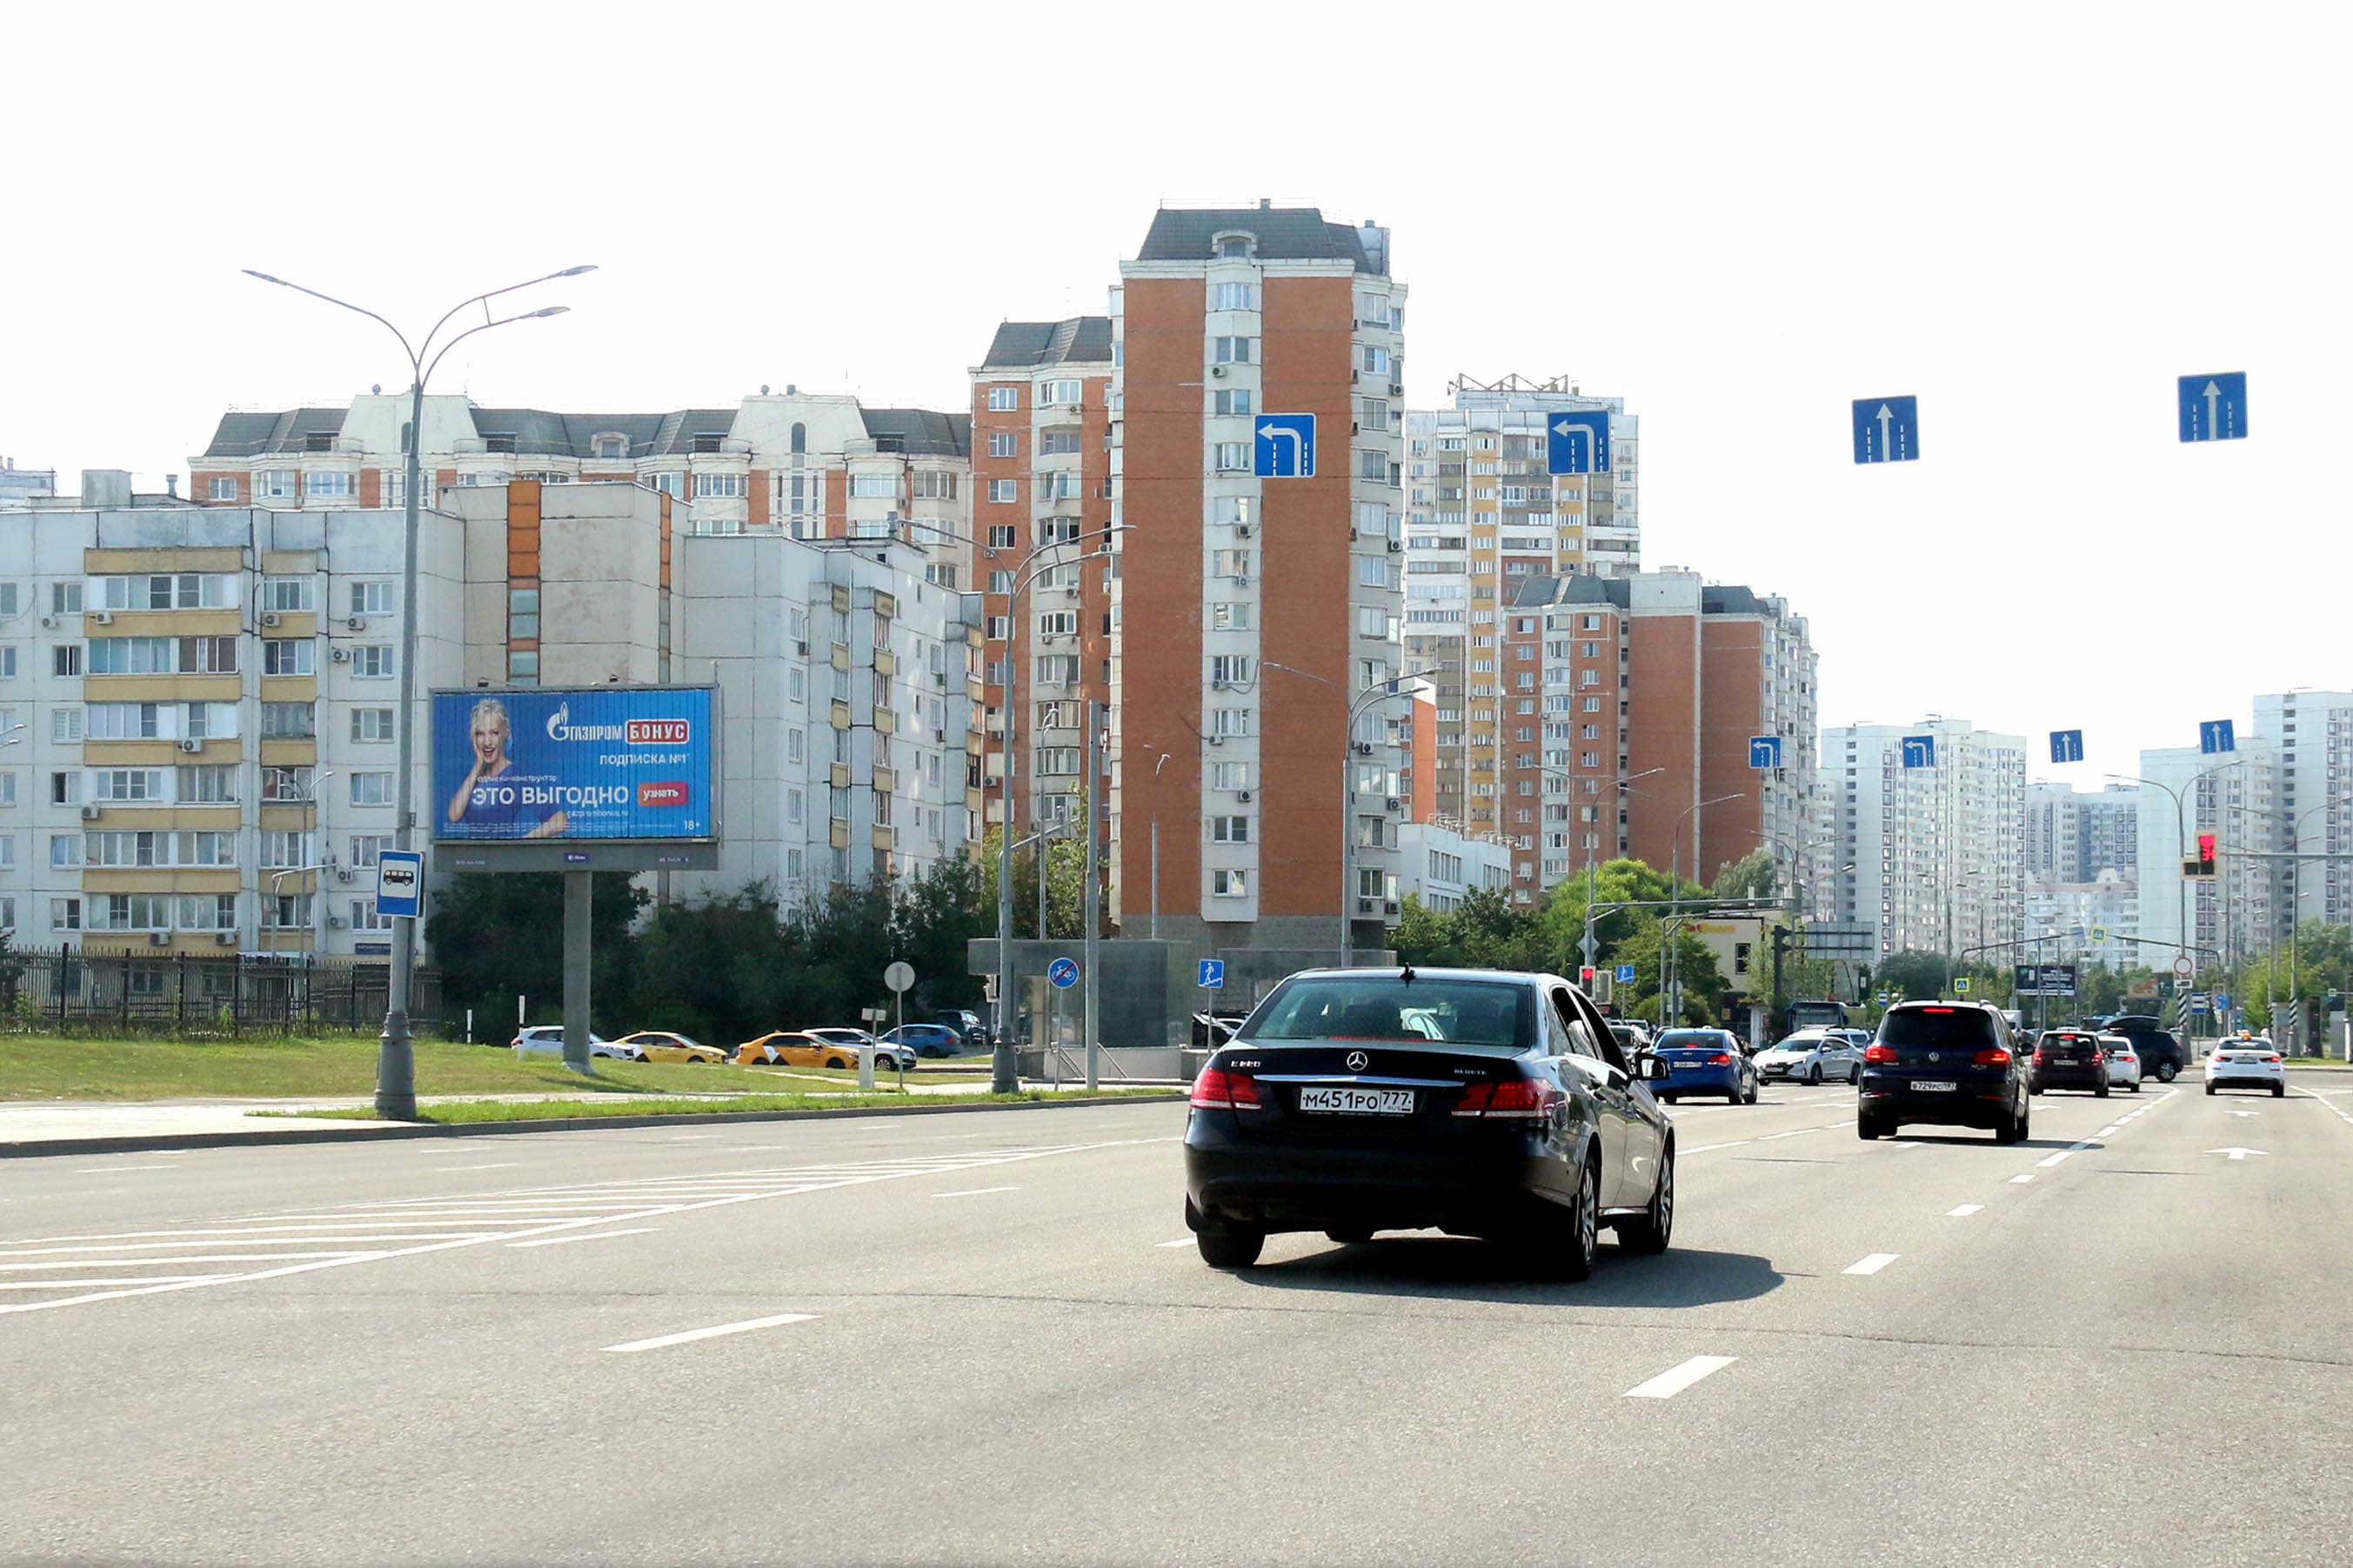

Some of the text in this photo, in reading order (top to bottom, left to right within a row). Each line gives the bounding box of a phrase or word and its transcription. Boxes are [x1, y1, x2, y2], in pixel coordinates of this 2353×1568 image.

[570, 724, 685, 741] ГАЗПРОМ БОНУС
[599, 753, 666, 767] ПОДПИСКА
[471, 785, 629, 808] ЭТО ВЫГОДНО
[643, 789, 679, 801] узнать
[684, 820, 700, 830] 18+
[1381, 1091, 1410, 1105] 777
